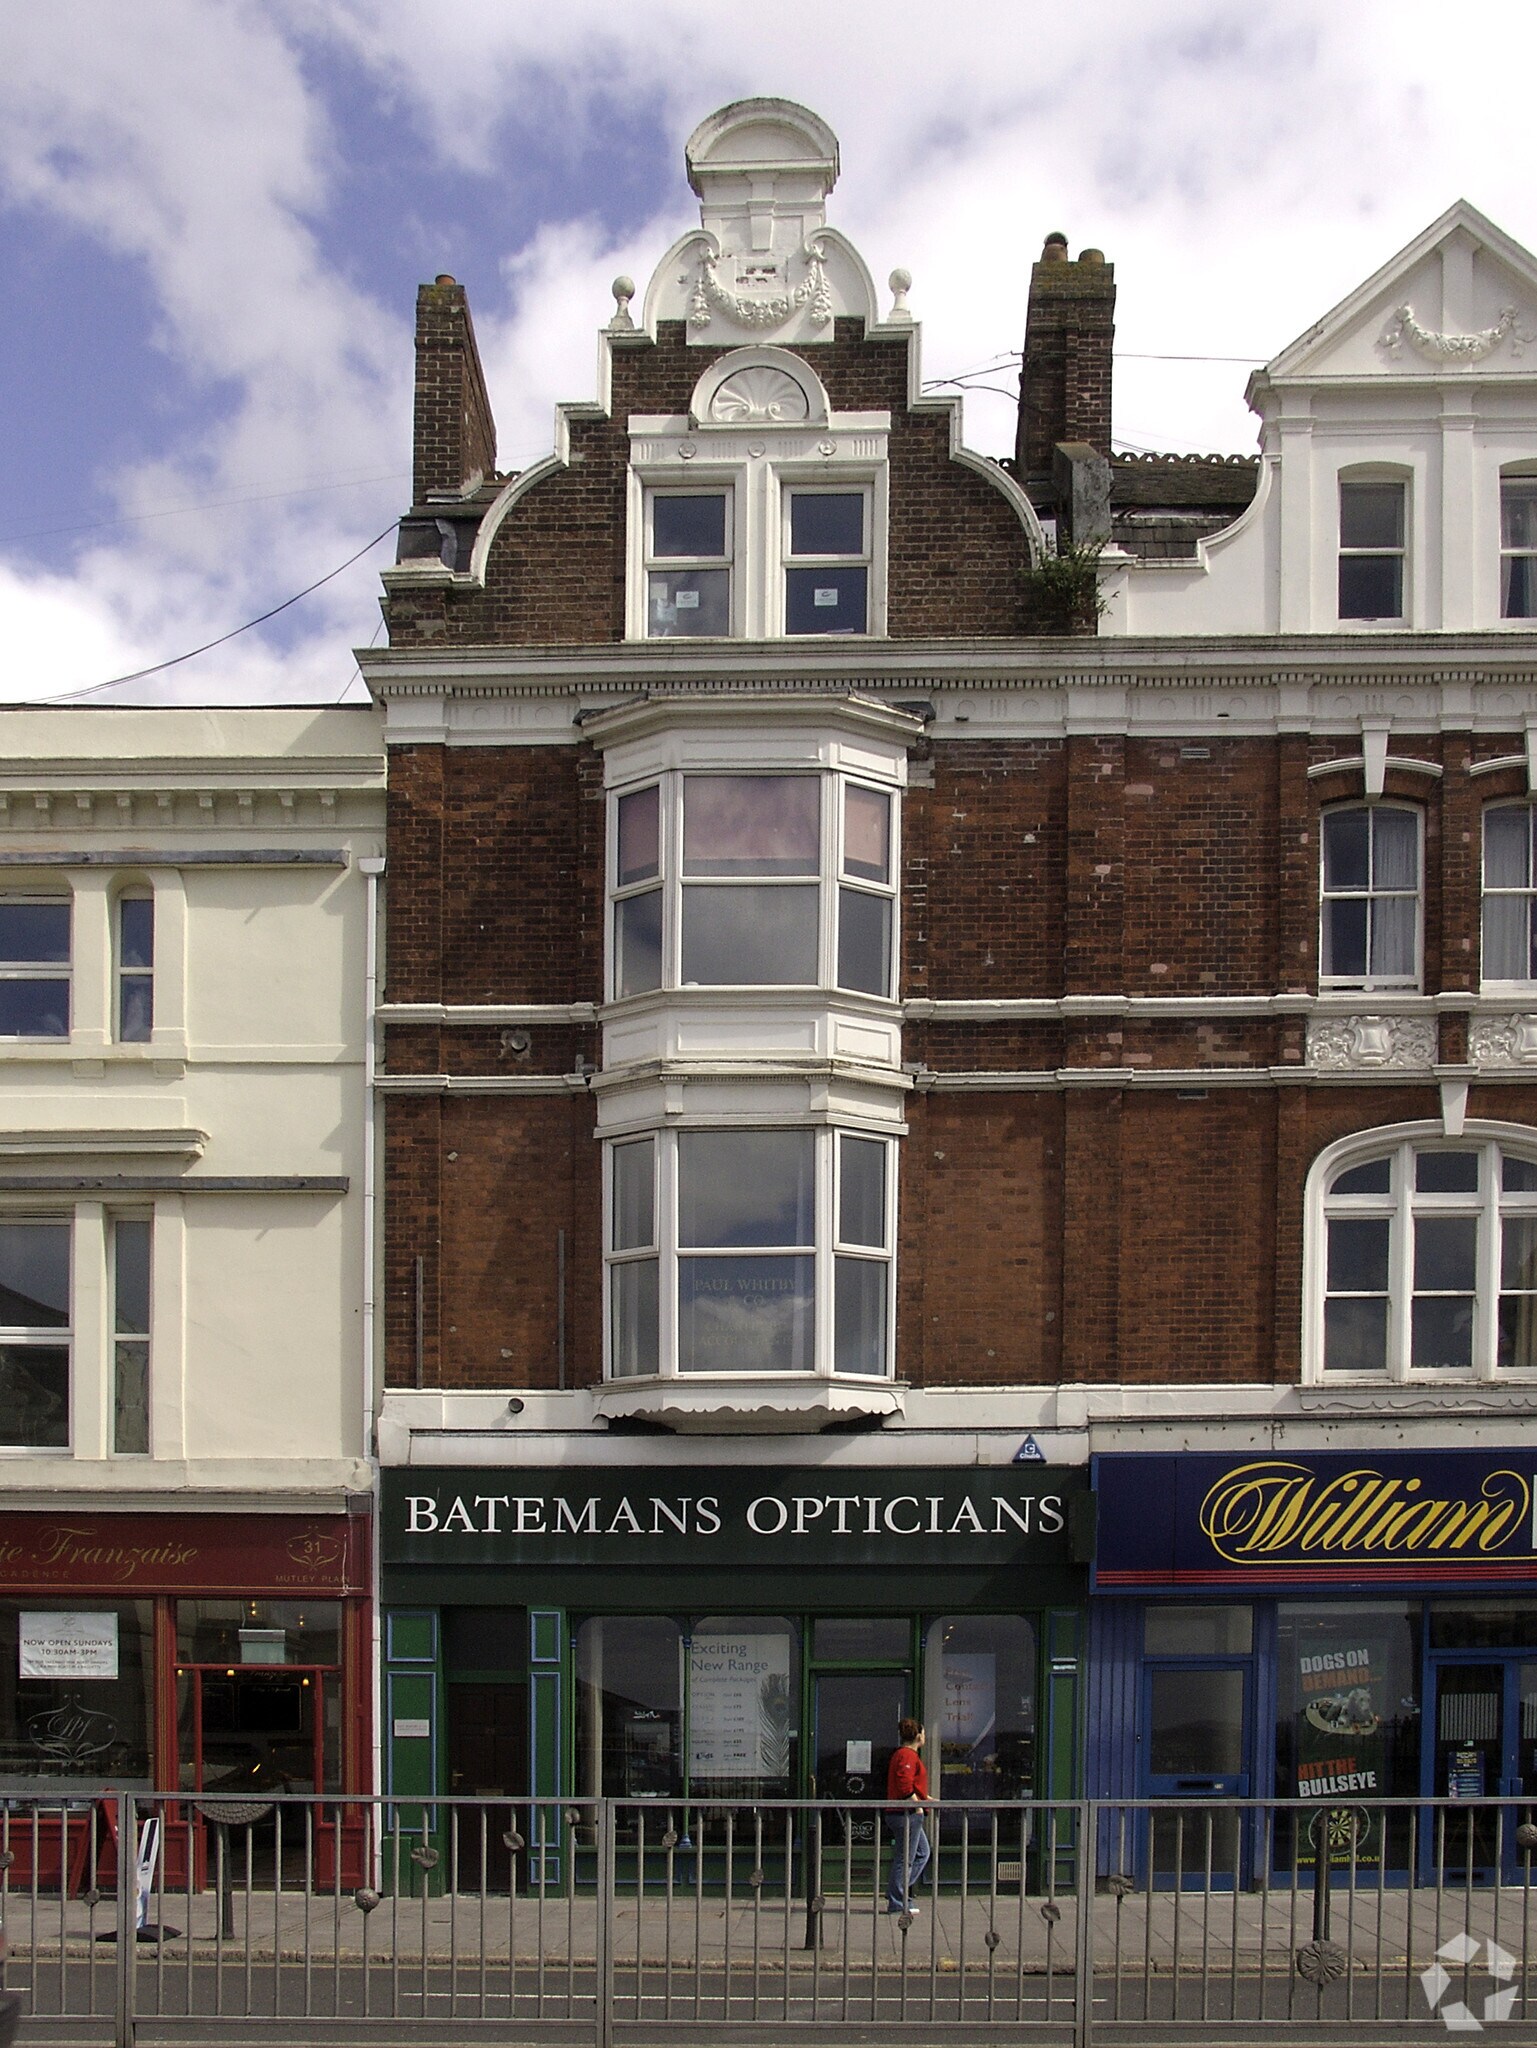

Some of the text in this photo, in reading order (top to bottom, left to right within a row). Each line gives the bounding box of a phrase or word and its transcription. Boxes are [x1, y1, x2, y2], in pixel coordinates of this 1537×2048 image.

[694, 1278, 796, 1291] PAUL WHITBY
[404, 1495, 1064, 1534] BATEMANS OPTICIANS
[1200, 1461, 1530, 1563] William
[304, 1541, 321, 1554] 31
[275, 1575, 315, 1583] MUTLEY
[691, 1642, 747, 1657] Exciting
[691, 1659, 769, 1674] New Range
[1300, 1648, 1369, 1674] DOGS ON
[1297, 1757, 1357, 1780] HIT THE
[1298, 1771, 1377, 1797] BULLSEYE
